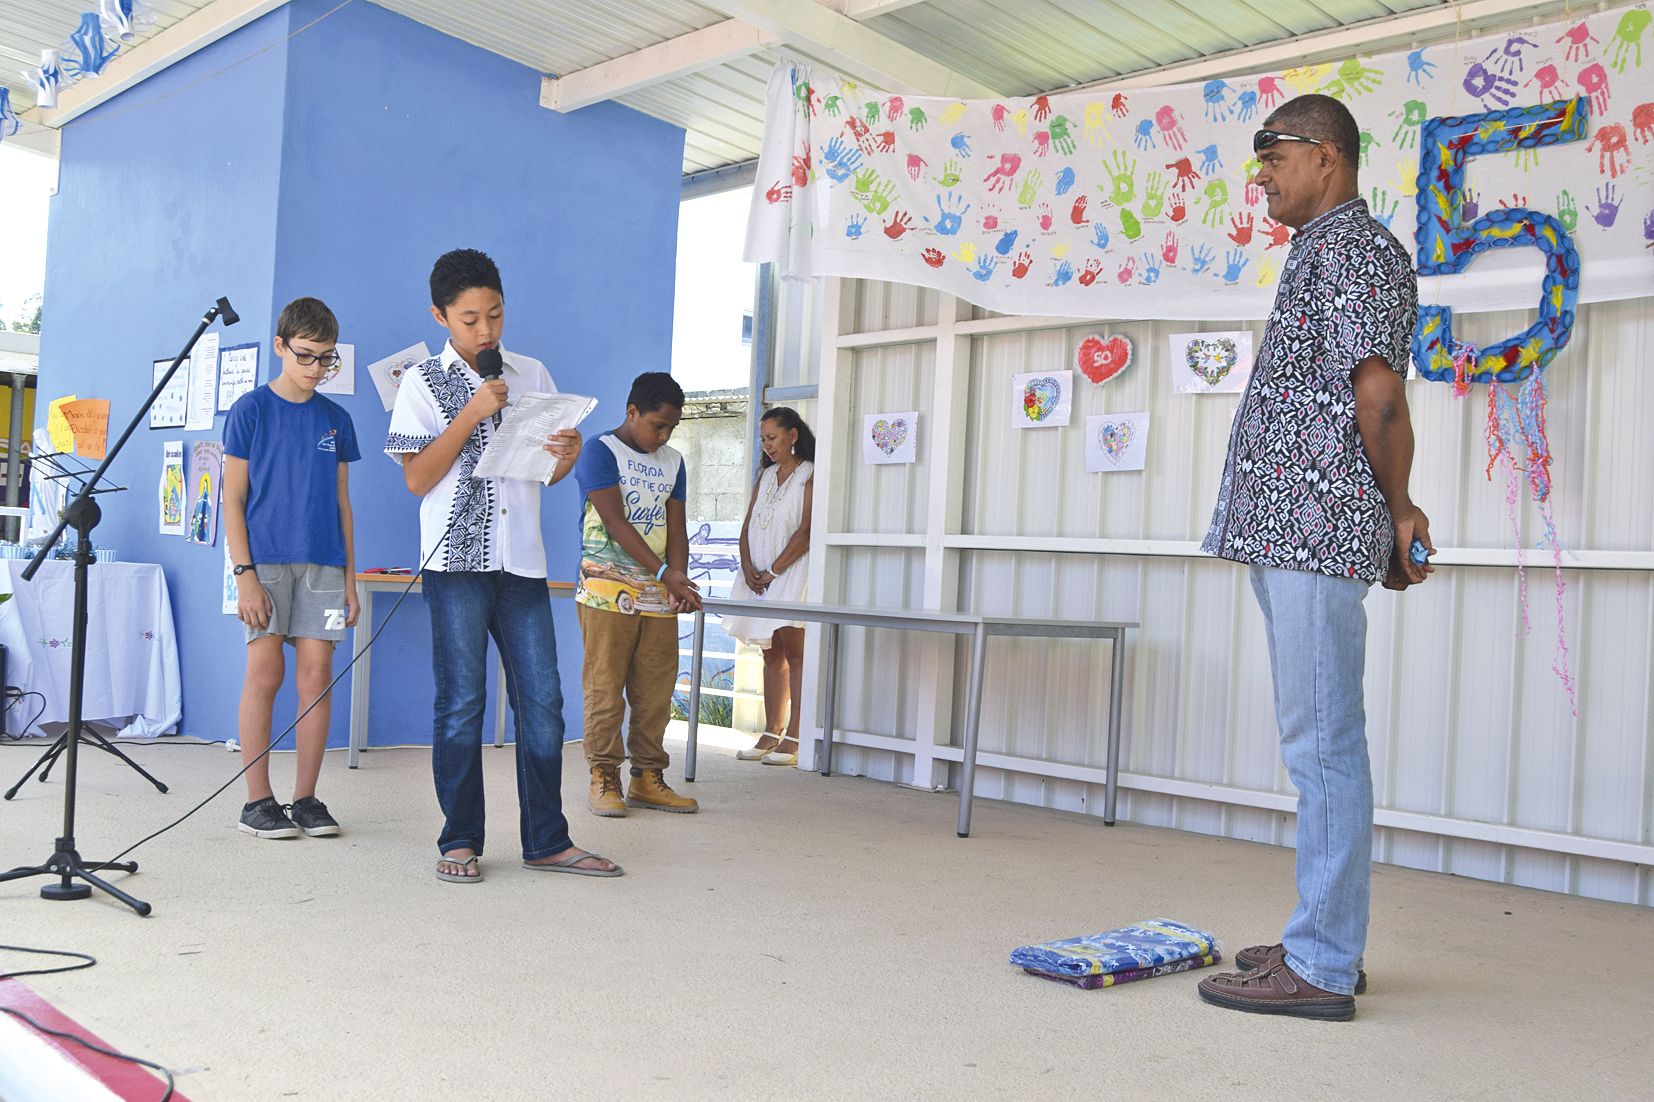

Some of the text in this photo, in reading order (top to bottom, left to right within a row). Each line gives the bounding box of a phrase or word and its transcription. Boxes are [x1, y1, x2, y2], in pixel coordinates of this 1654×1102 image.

[1093, 351, 1112, 367] 50
[627, 459, 664, 477] FLORIDA
[630, 476, 641, 486] OF
